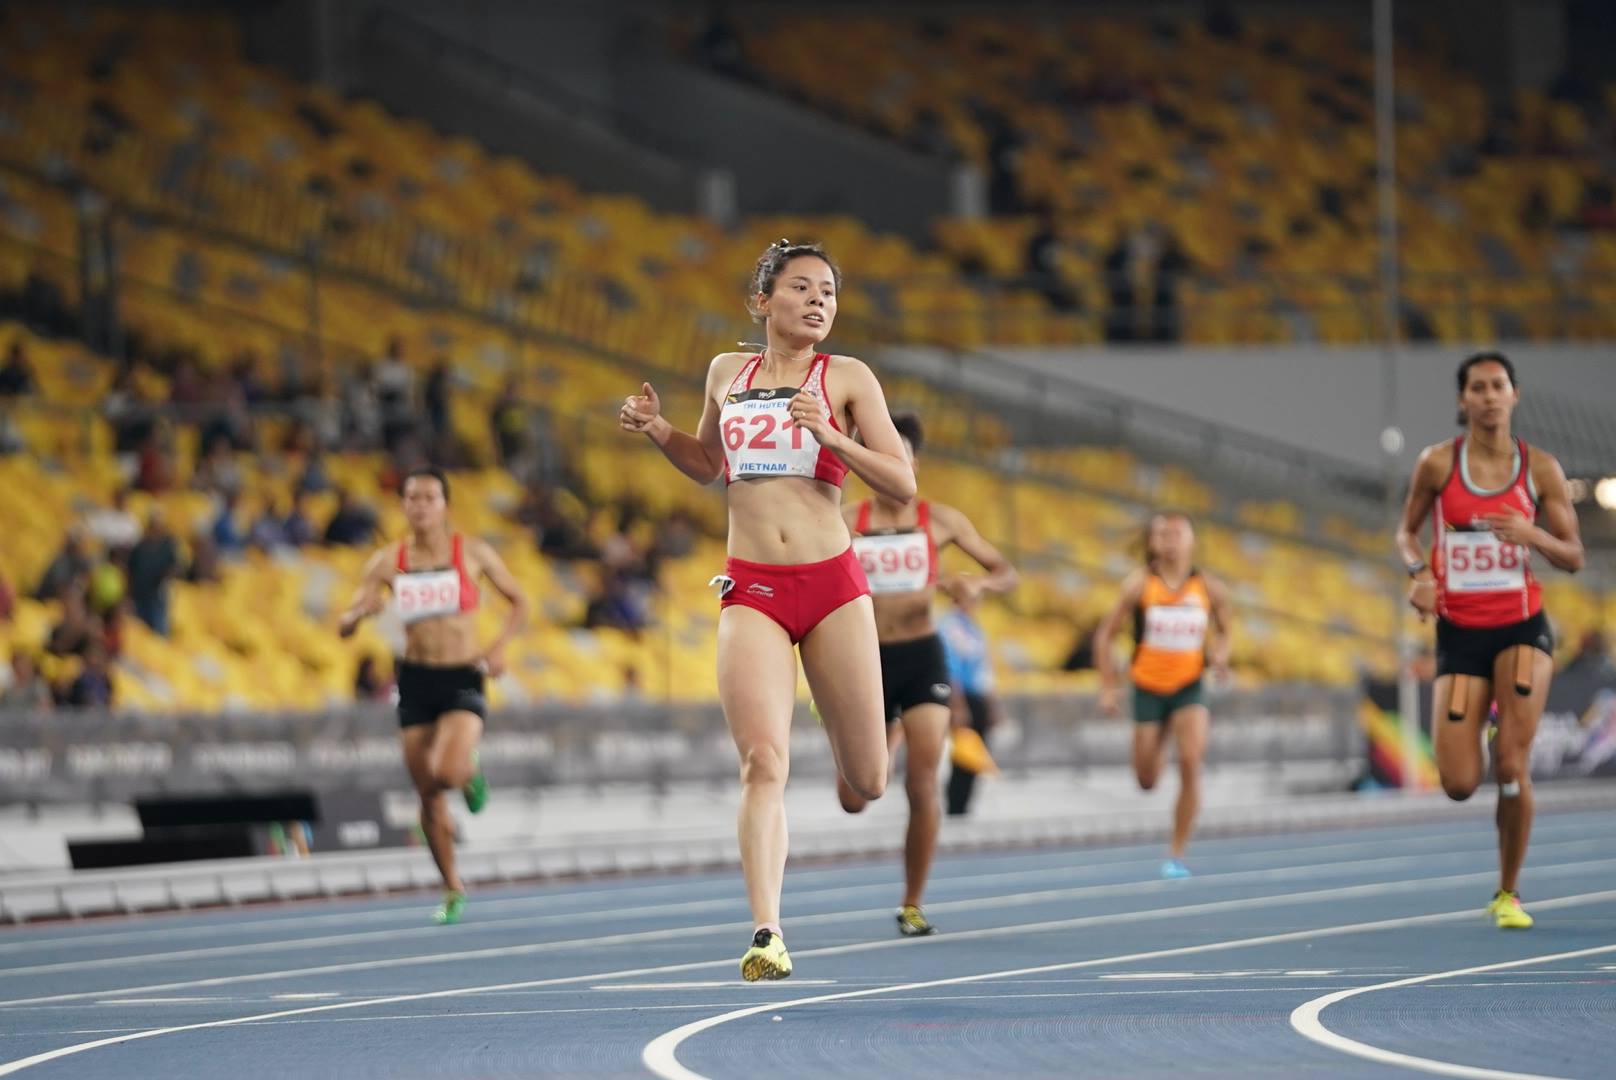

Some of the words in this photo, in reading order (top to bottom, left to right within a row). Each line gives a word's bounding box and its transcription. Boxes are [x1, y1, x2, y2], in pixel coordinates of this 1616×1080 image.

[723, 413, 804, 452] 621
[739, 462, 788, 472] VIETNAM
[1451, 544, 1519, 572] 558
[401, 582, 457, 612] 590
